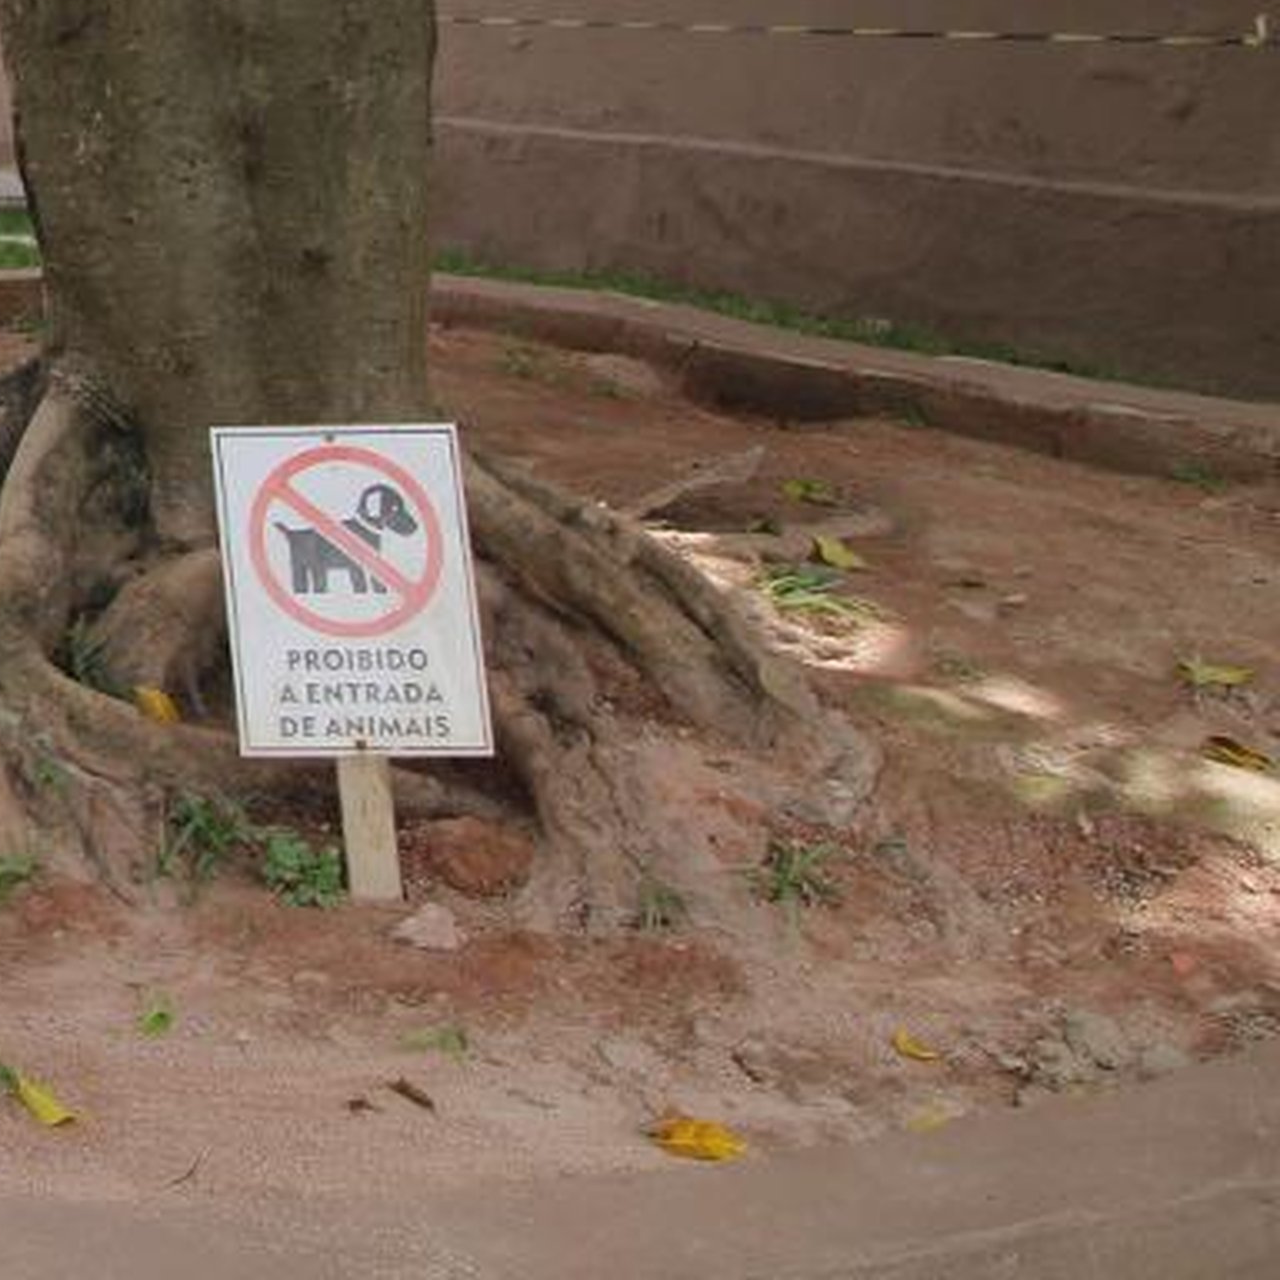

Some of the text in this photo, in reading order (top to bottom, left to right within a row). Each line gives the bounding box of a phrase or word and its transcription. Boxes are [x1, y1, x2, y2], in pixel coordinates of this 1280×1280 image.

[287, 648, 428, 671] PROIBIDO
[280, 682, 444, 705] A ENTRADA
[280, 715, 451, 738] DE ANIMAIS
